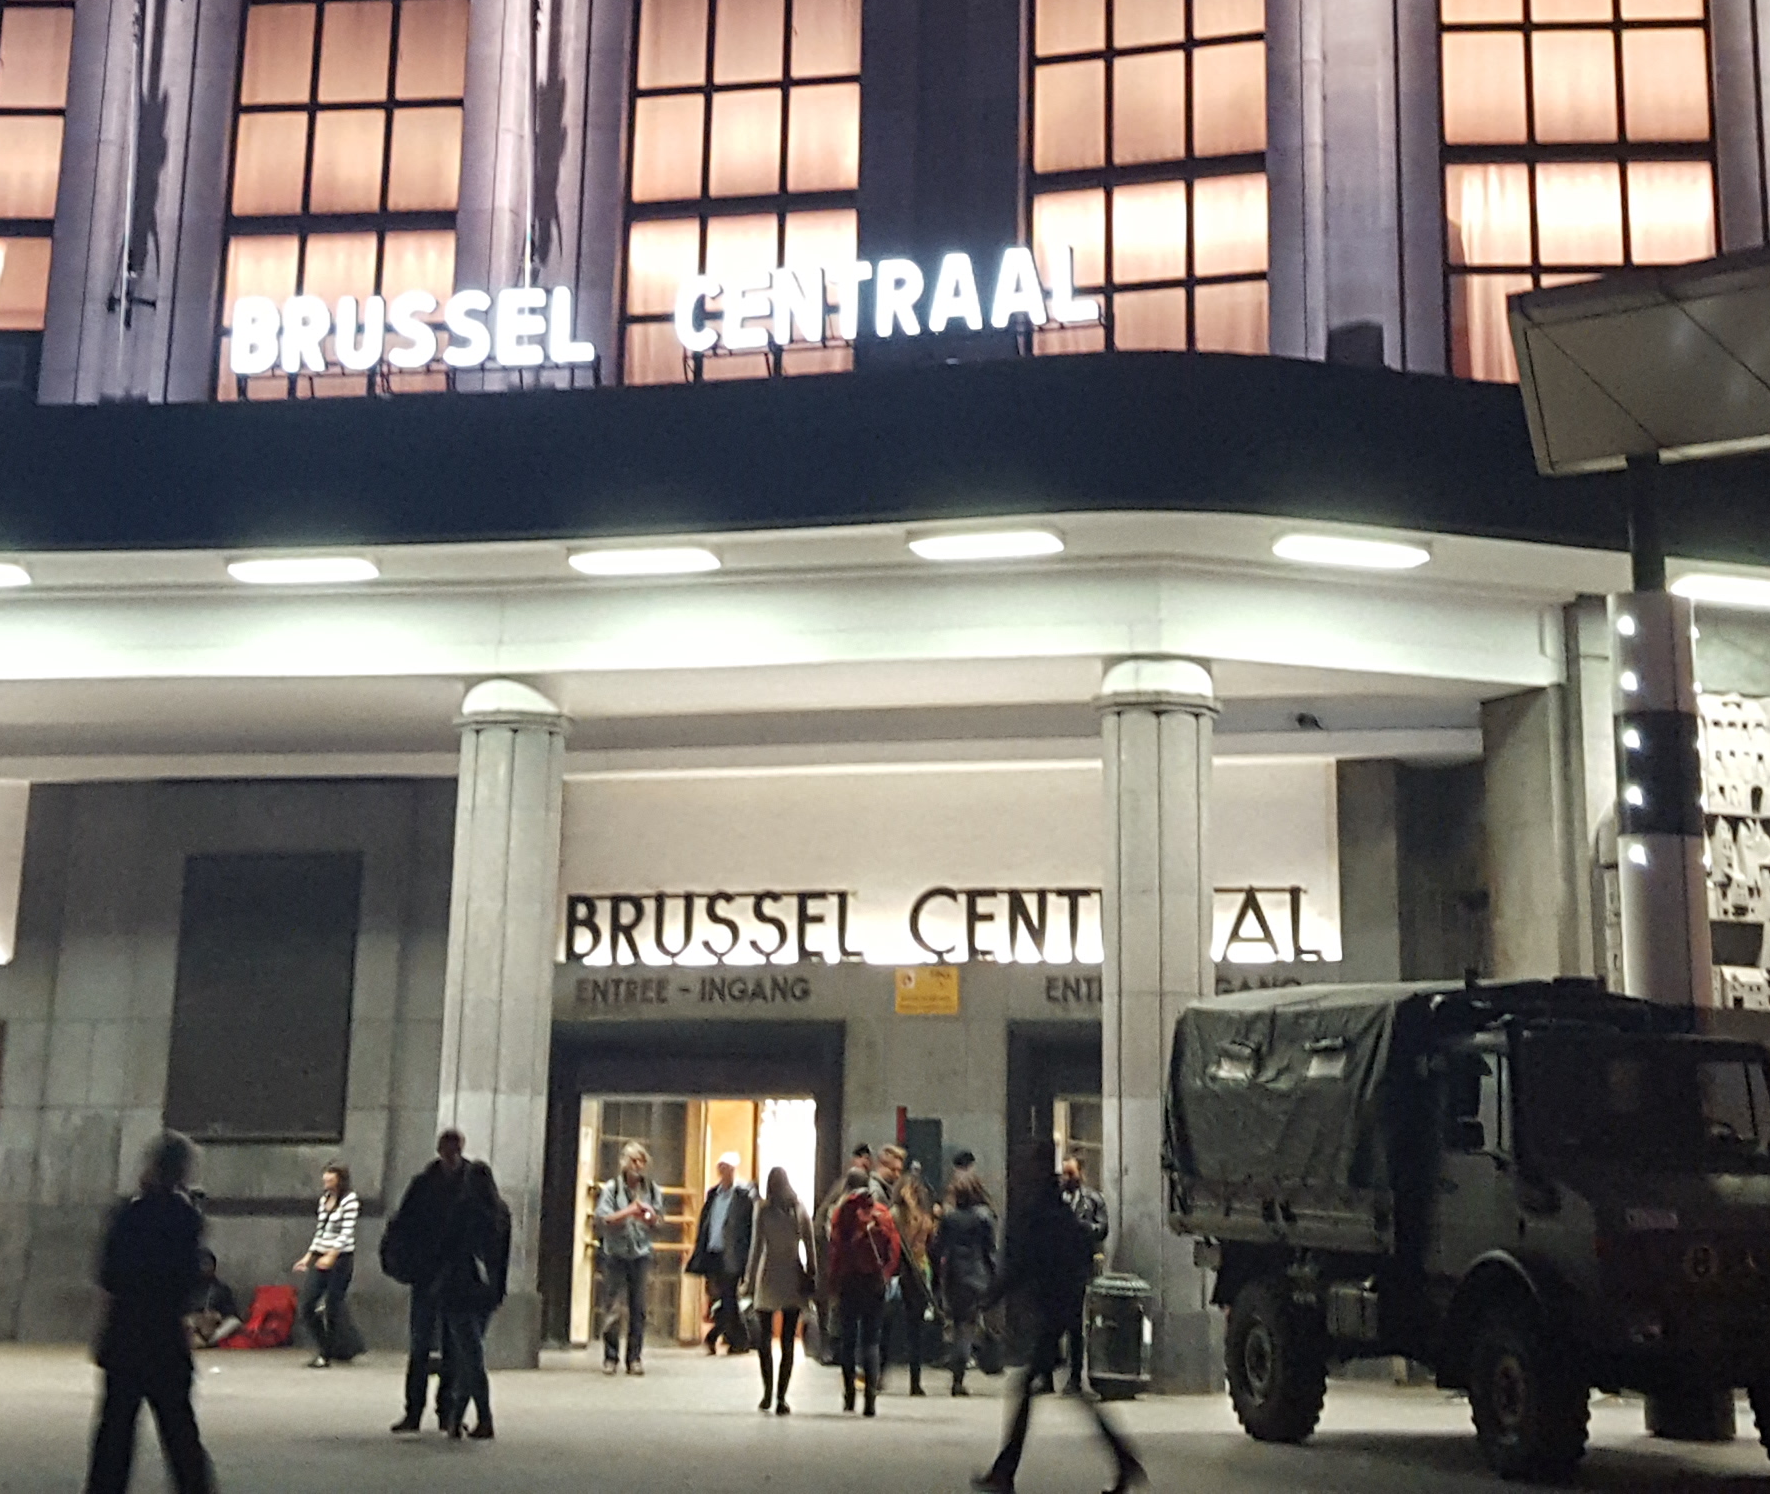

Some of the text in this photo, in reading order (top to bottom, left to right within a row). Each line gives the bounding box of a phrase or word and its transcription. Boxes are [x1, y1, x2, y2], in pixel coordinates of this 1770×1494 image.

[230, 246, 1100, 374] BRUSSEL CENTRAAL
[565, 885, 1323, 961] BRUSSEL CENTAL
[576, 977, 671, 1004] ENTREE
[700, 976, 812, 1003] INGANG
